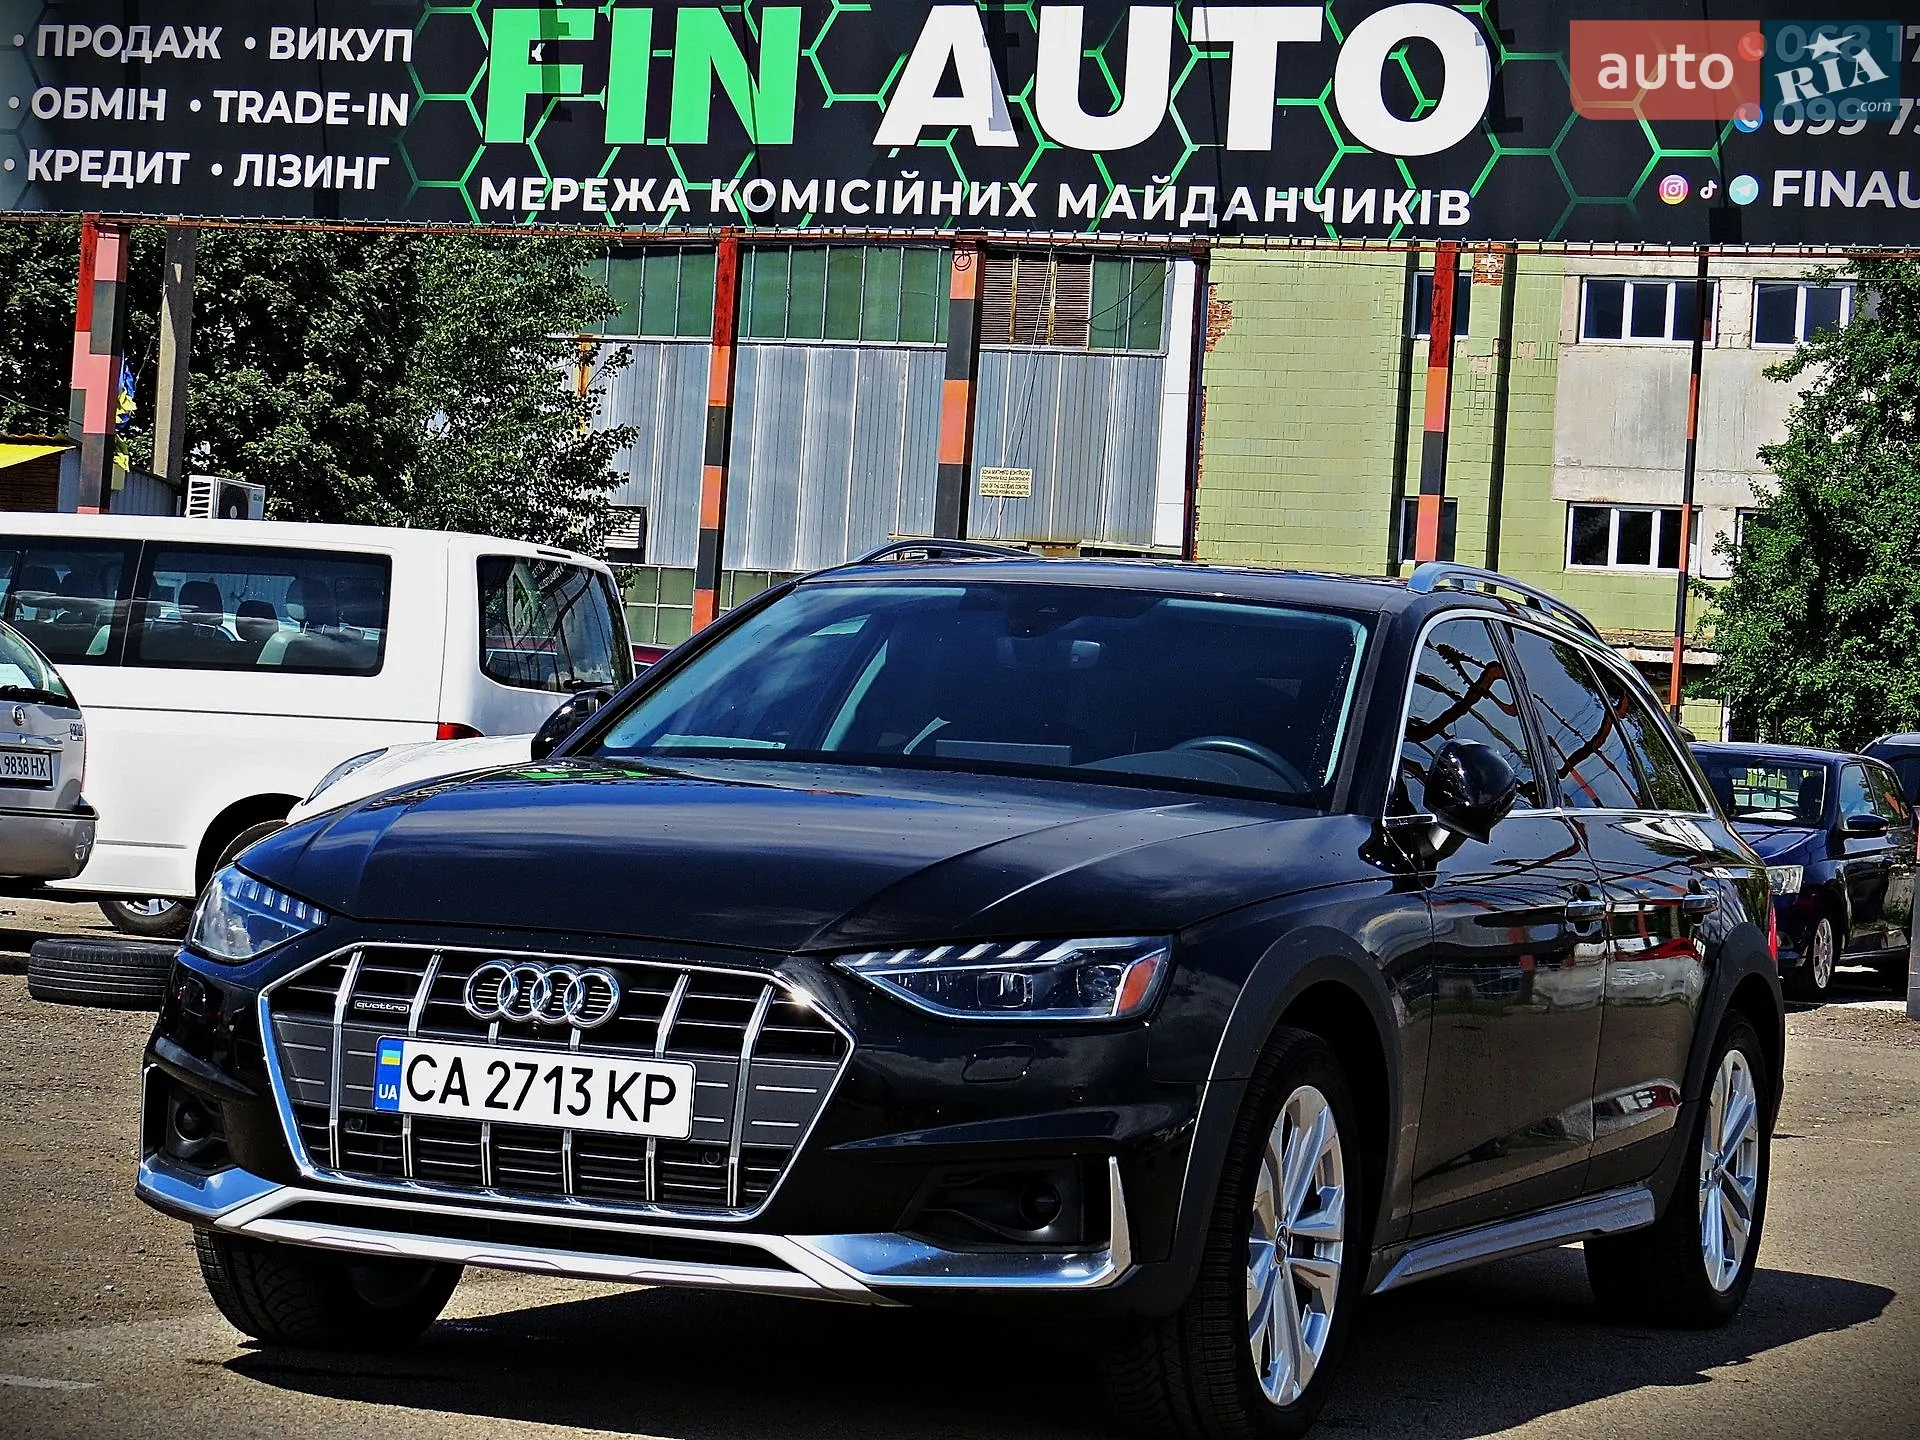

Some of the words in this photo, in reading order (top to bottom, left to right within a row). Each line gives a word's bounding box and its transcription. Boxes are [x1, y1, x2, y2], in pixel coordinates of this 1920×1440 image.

[37, 24, 223, 64] ПРОДАЖ
[269, 26, 413, 62] ВИКУП
[484, 7, 802, 144] FIN
[872, 2, 1492, 157] AUTO
[31, 87, 167, 120] ОБМІН
[213, 90, 409, 126] TRADE-IN
[27, 149, 191, 189] КРЕДИТ
[233, 153, 390, 190] ЛІЗИНГ
[479, 177, 691, 213] МЕРЕЖА
[710, 170, 1038, 218] КОМІСІЙНИХ
[1057, 175, 1471, 228] МАЙДАНЧИКІВ
[4, 756, 29, 775] 9838
[31, 757, 47, 777] HX
[356, 1002, 407, 1012] quattro
[378, 1084, 398, 1100] UA
[406, 1053, 470, 1107] CA
[484, 1060, 594, 1117] 2713
[606, 1070, 677, 1123] KP
